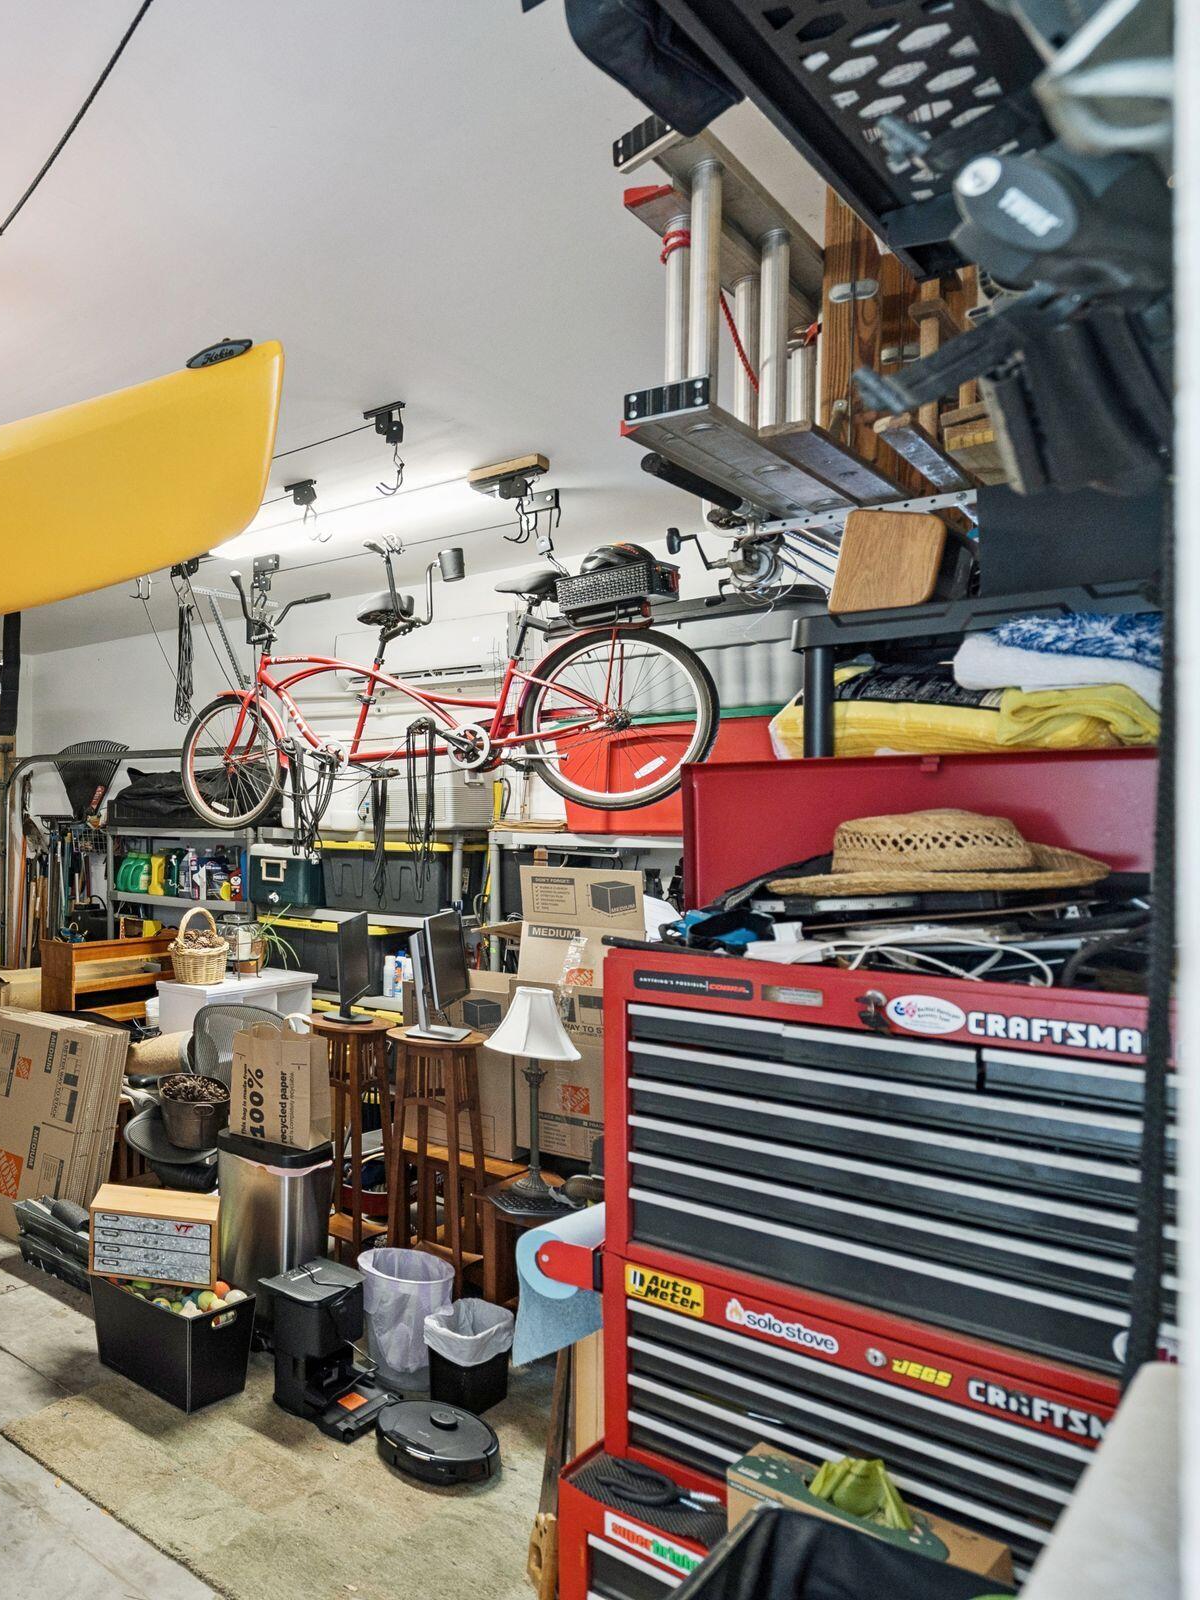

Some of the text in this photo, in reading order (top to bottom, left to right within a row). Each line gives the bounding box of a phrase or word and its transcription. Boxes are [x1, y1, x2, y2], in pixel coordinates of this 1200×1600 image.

[532, 927, 576, 938] MEDIUM
[582, 1025, 595, 1033] TO
[966, 1011, 1144, 1055] CRAFTSMA
[46, 1033, 57, 1071] MEDIUM
[247, 1068, 266, 1138] 100%
[279, 1070, 288, 1144] recycled paper
[29, 1129, 39, 1167] MEDIUM
[175, 1224, 194, 1233] VT
[643, 1284, 701, 1310] Meter
[648, 1275, 692, 1297] Auto
[746, 1312, 835, 1351] solo stove
[892, 1358, 953, 1388] JEGS
